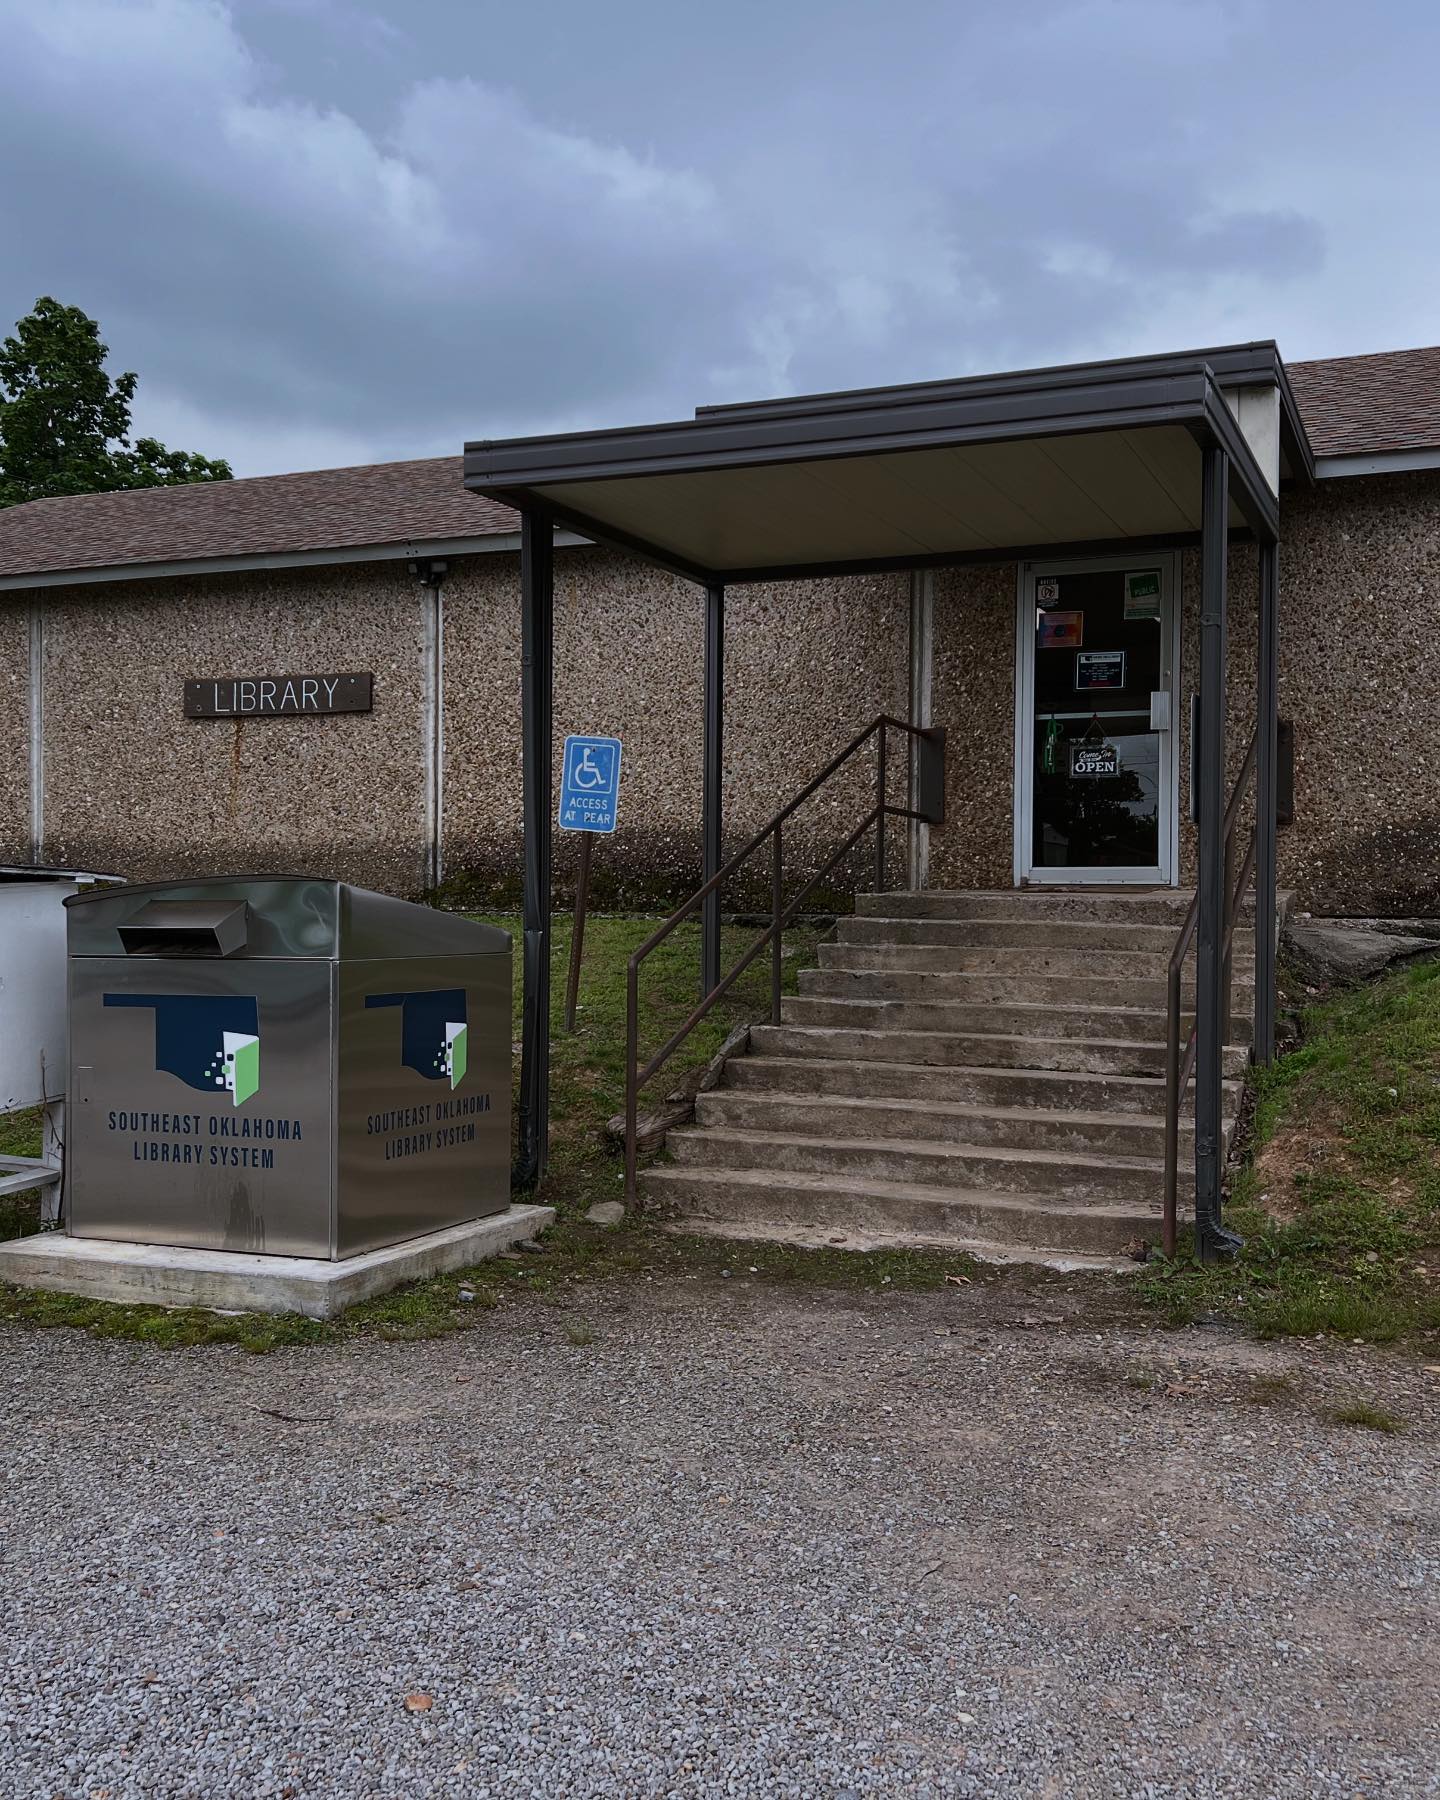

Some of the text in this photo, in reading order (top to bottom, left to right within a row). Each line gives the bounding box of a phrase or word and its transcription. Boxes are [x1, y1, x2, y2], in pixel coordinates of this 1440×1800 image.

[214, 678, 339, 712] LIBRARY
[1074, 761, 1115, 773] OPEN
[1078, 750, 1102, 761] Come
[564, 810, 611, 824] AT REAR
[569, 797, 608, 810] ACCESS
[108, 1111, 302, 1140] SOUTHEAST OKLAHOMA
[367, 1094, 490, 1135] SOUTHEAST OKLAHOMA
[134, 1141, 274, 1168] LIBRARY SYSTEM
[385, 1123, 475, 1160] LIBRARY SYSTEM
